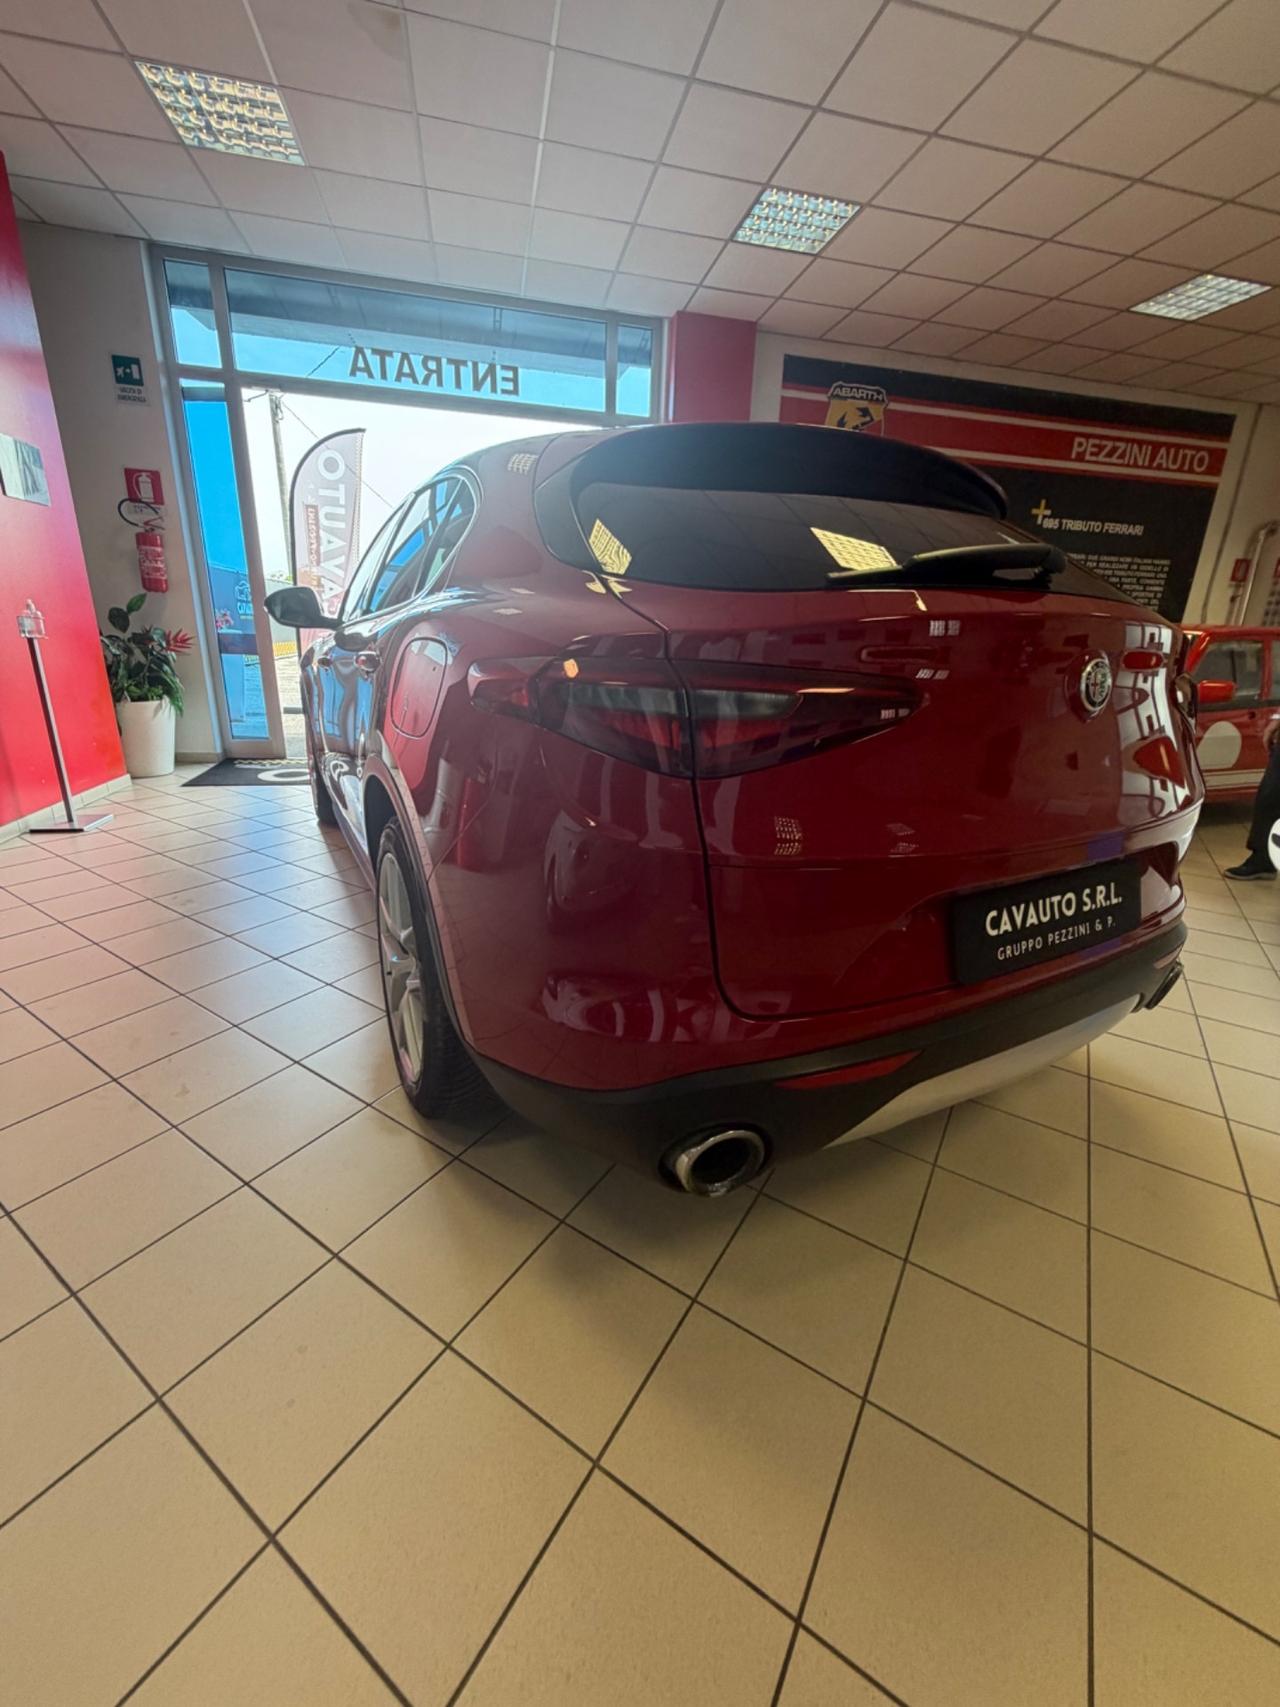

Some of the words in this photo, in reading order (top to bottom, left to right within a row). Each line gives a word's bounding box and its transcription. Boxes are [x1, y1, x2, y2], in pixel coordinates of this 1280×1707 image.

[833, 387, 883, 401] ABARTH
[1071, 437, 1152, 467] PEZZINI
[1153, 447, 1209, 473] AUTO
[1060, 519, 1102, 533] TRIBUTO
[1103, 521, 1145, 536] FERRARI
[985, 892, 1076, 936] CAVAUTO
[1082, 882, 1122, 912] S.R.L.
[997, 937, 1043, 960] GRUPPO
[1048, 922, 1090, 946] PEZZINI
[1095, 918, 1103, 931] &
